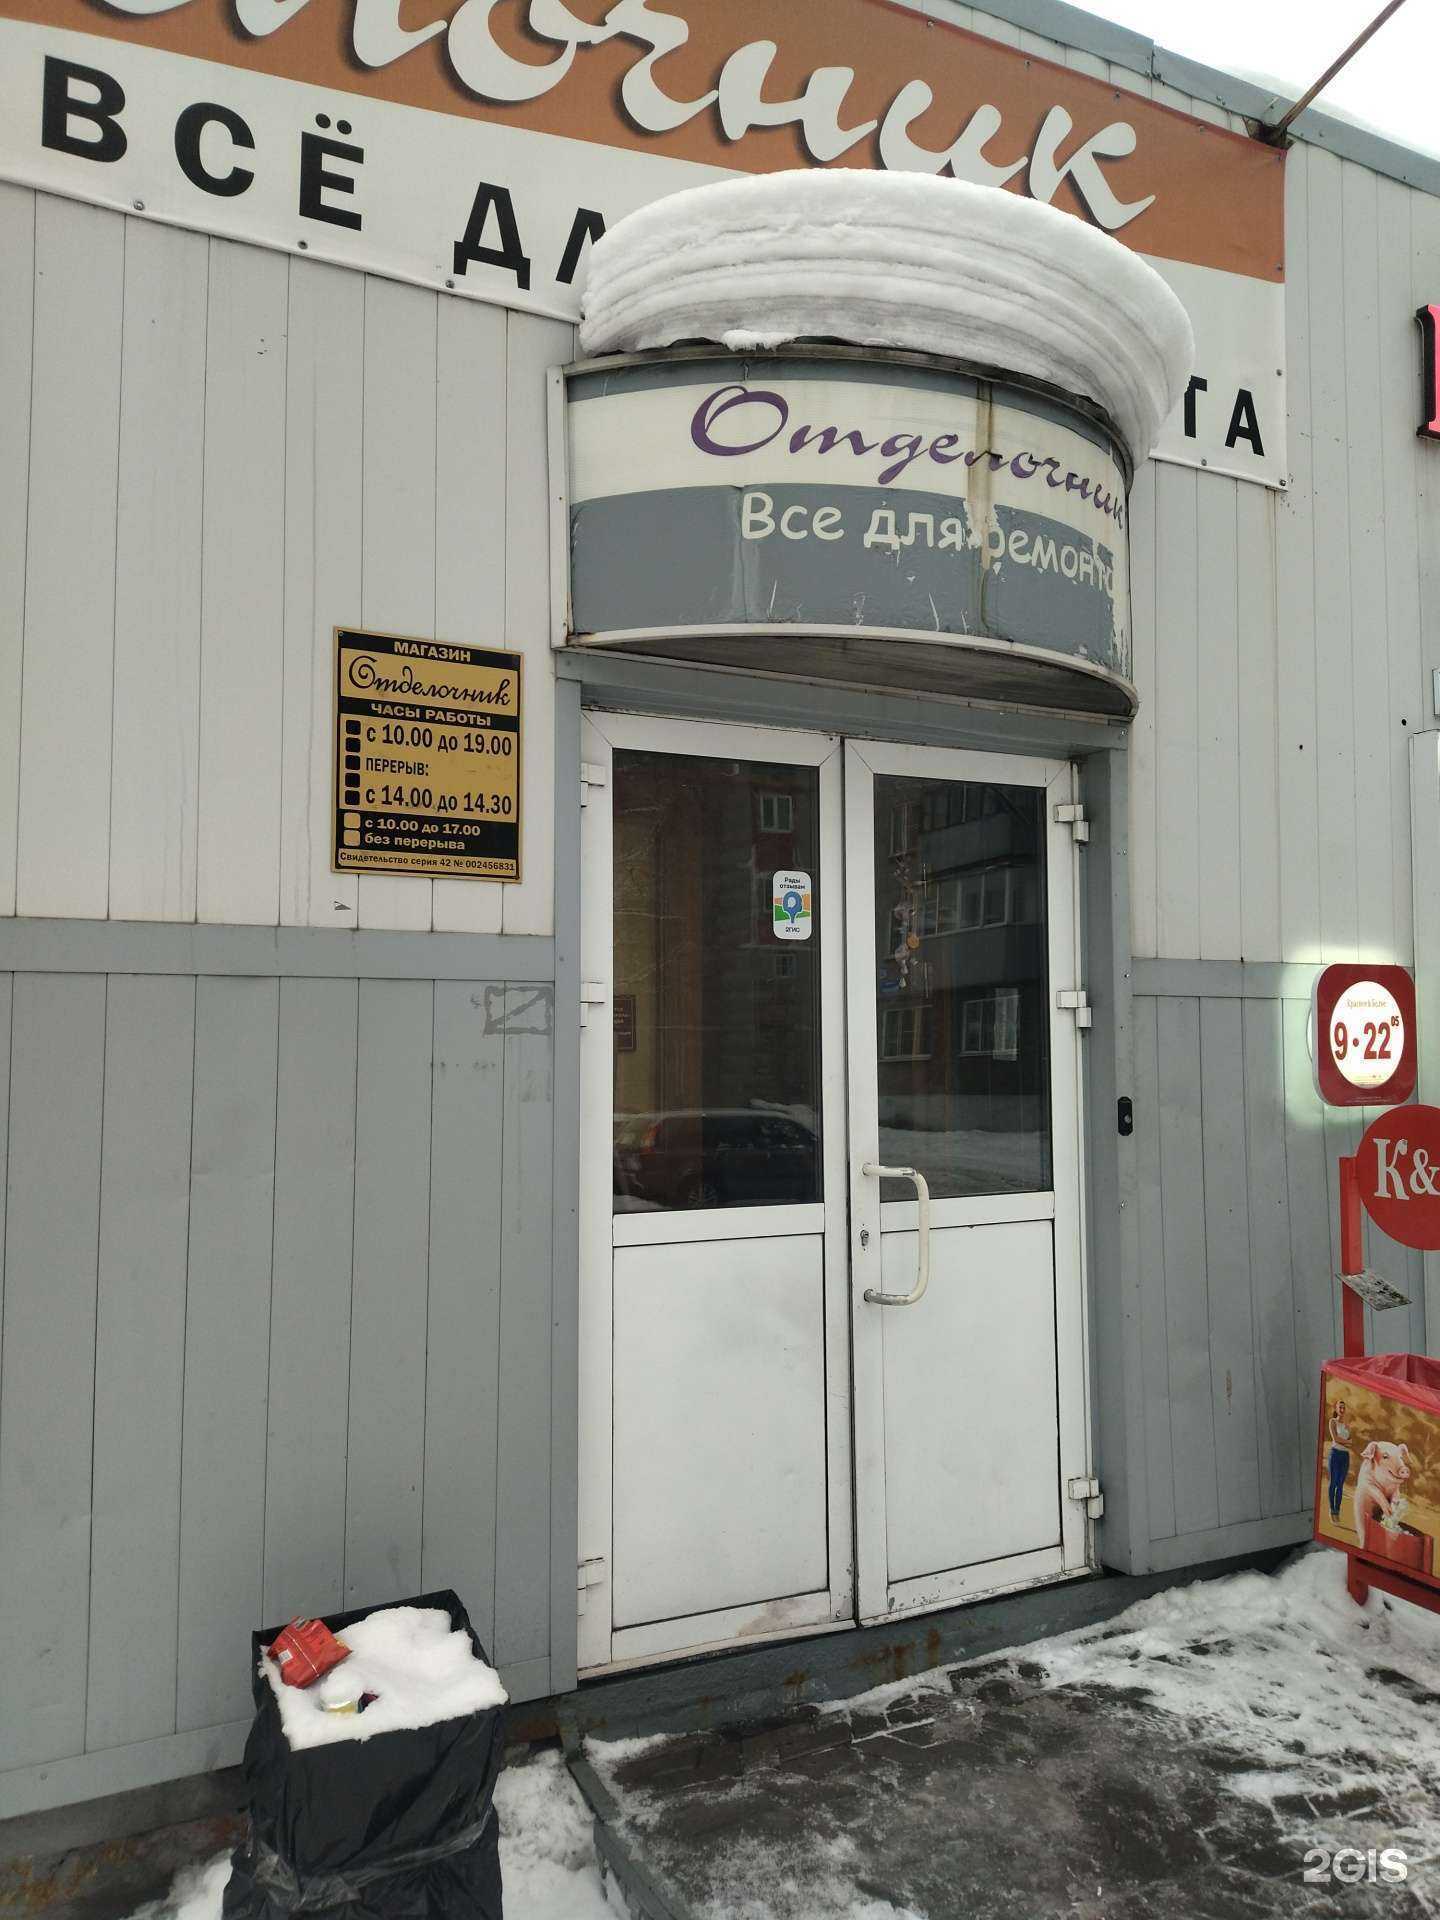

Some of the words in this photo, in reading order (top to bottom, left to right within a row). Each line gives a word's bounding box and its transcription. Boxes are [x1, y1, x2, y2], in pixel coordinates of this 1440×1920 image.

[42, 55, 366, 231] ВСЁ
[690, 385, 1123, 530] Отделочник
[742, 492, 844, 540] Все
[863, 502, 963, 552] для
[394, 641, 471, 662] МАГАЗИН
[349, 655, 511, 706] Отделочник
[371, 703, 420, 718] ЧАСЫ
[425, 709, 491, 726] РАБОТЫ
[382, 724, 433, 748] 10.00
[437, 734, 458, 753] до
[463, 733, 512, 756] 19.00
[365, 757, 430, 777] ПЕРЕРЫВ:
[381, 785, 433, 808] 14.00
[437, 795, 458, 813] до
[463, 792, 512, 815] 14.30
[377, 818, 419, 831] 10.00
[422, 824, 438, 834] до
[442, 823, 481, 836] 17.00
[364, 833, 390, 845] без
[394, 837, 465, 851] перерыва
[340, 852, 408, 864] Свидетельство
[411, 858, 437, 867] серия
[440, 859, 451, 867] 42
[453, 860, 463, 868] №
